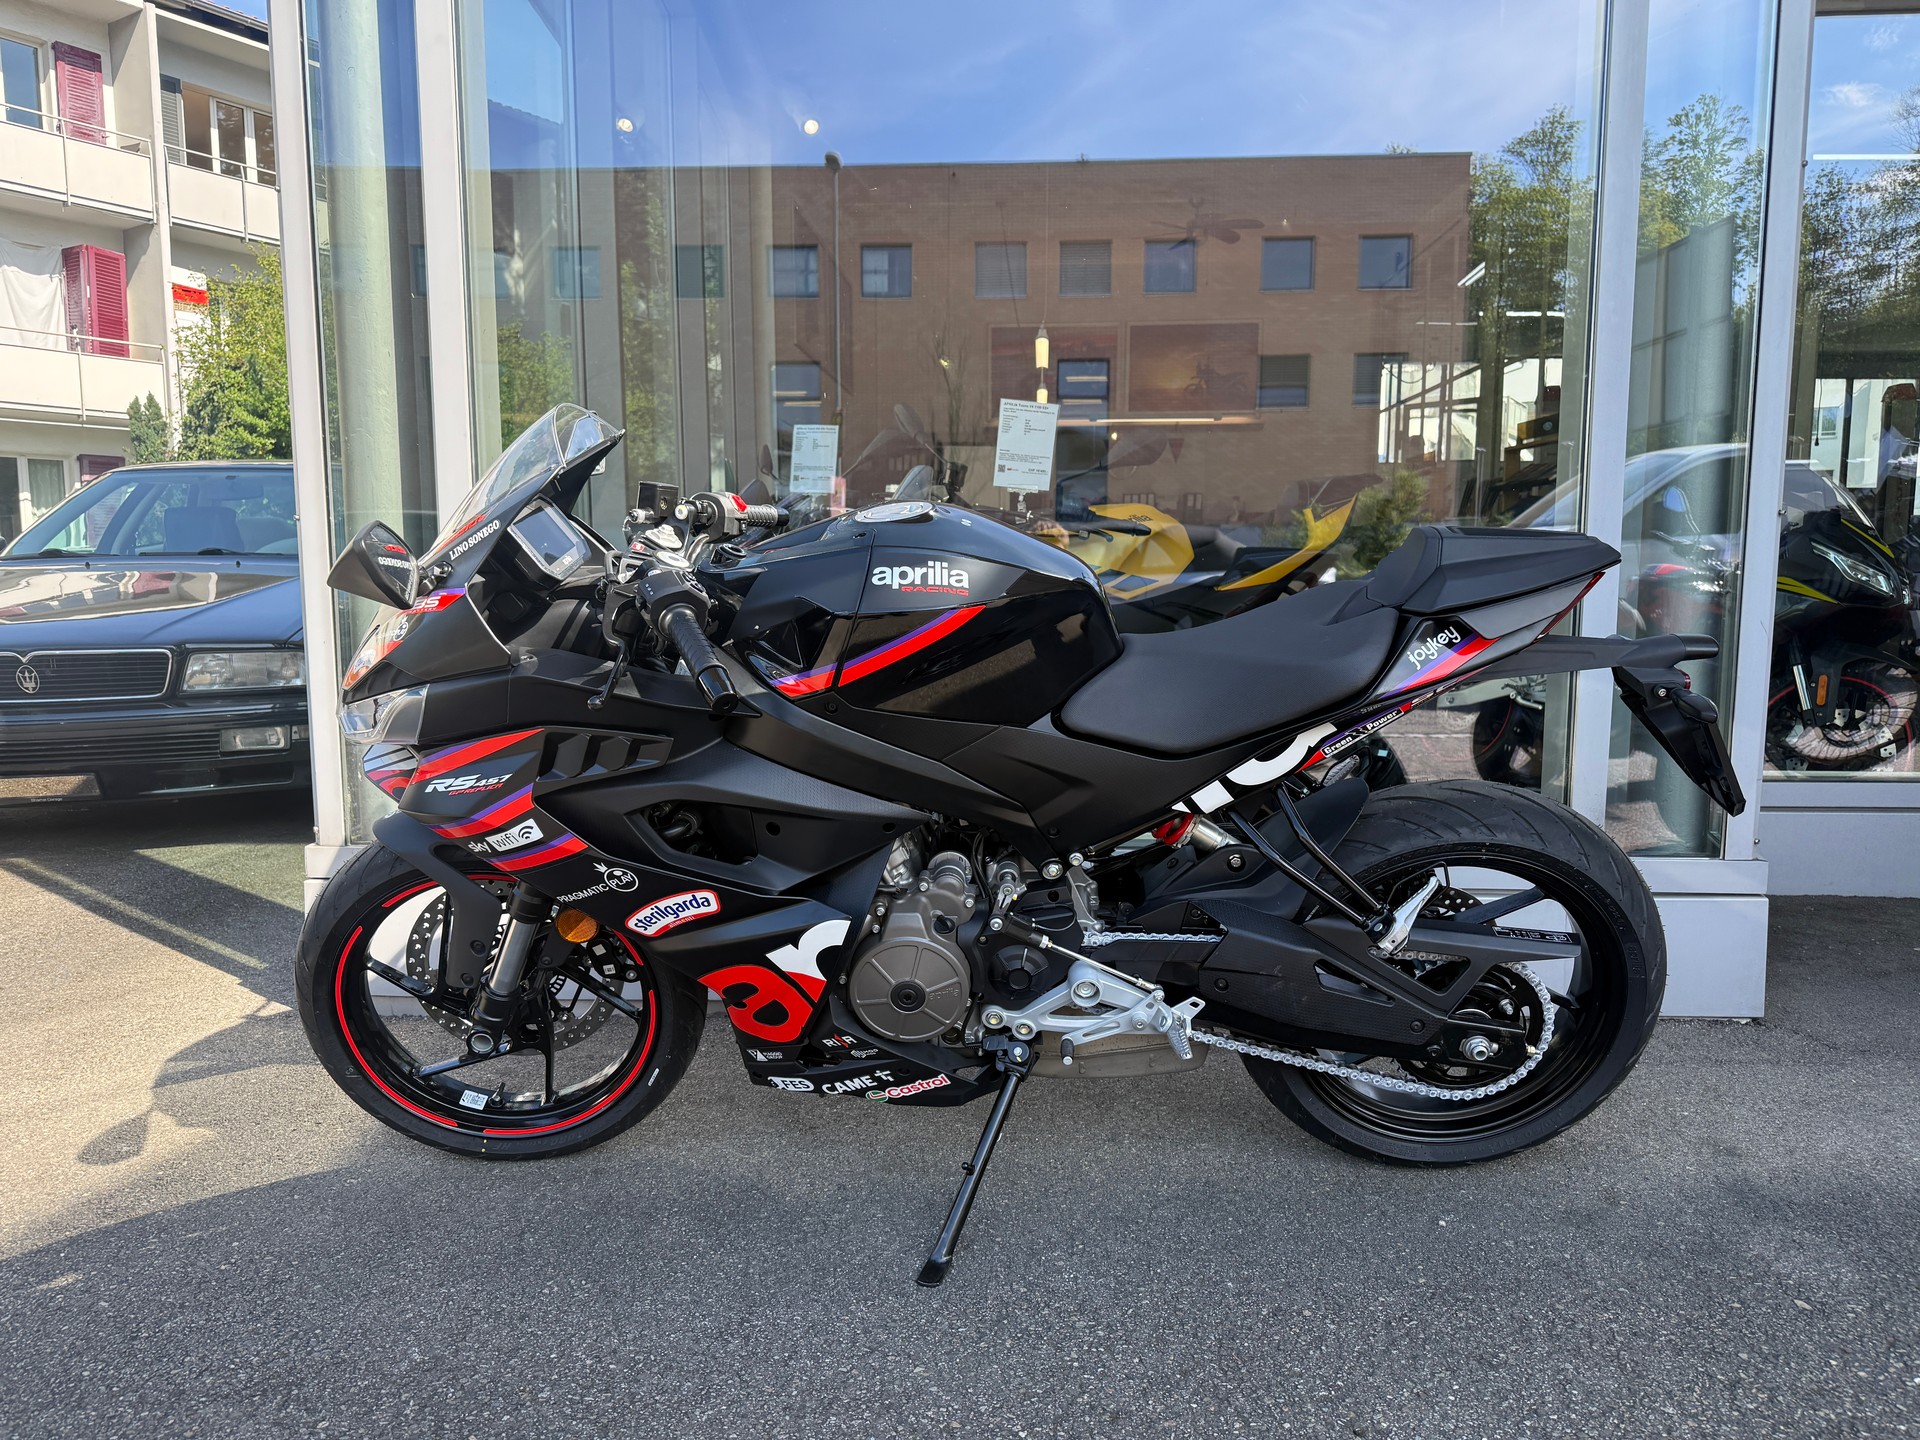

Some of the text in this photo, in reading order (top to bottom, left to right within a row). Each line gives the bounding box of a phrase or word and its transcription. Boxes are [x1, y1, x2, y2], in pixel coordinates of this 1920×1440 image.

[449, 541, 469, 560] LINO
[468, 520, 500, 547] SONEGO
[871, 560, 969, 589] aprilia
[901, 586, 969, 596] RACING
[1407, 626, 1461, 670] joykey
[1324, 736, 1353, 754] Green
[1366, 709, 1398, 731] Power
[425, 774, 513, 792] RS 457
[467, 832, 519, 853] sky wifi
[556, 873, 634, 903] PRAGMATIC PLAY
[634, 894, 712, 931] sterilgarda
[822, 1075, 878, 1095] CAME
[887, 1074, 950, 1098] Castrol
